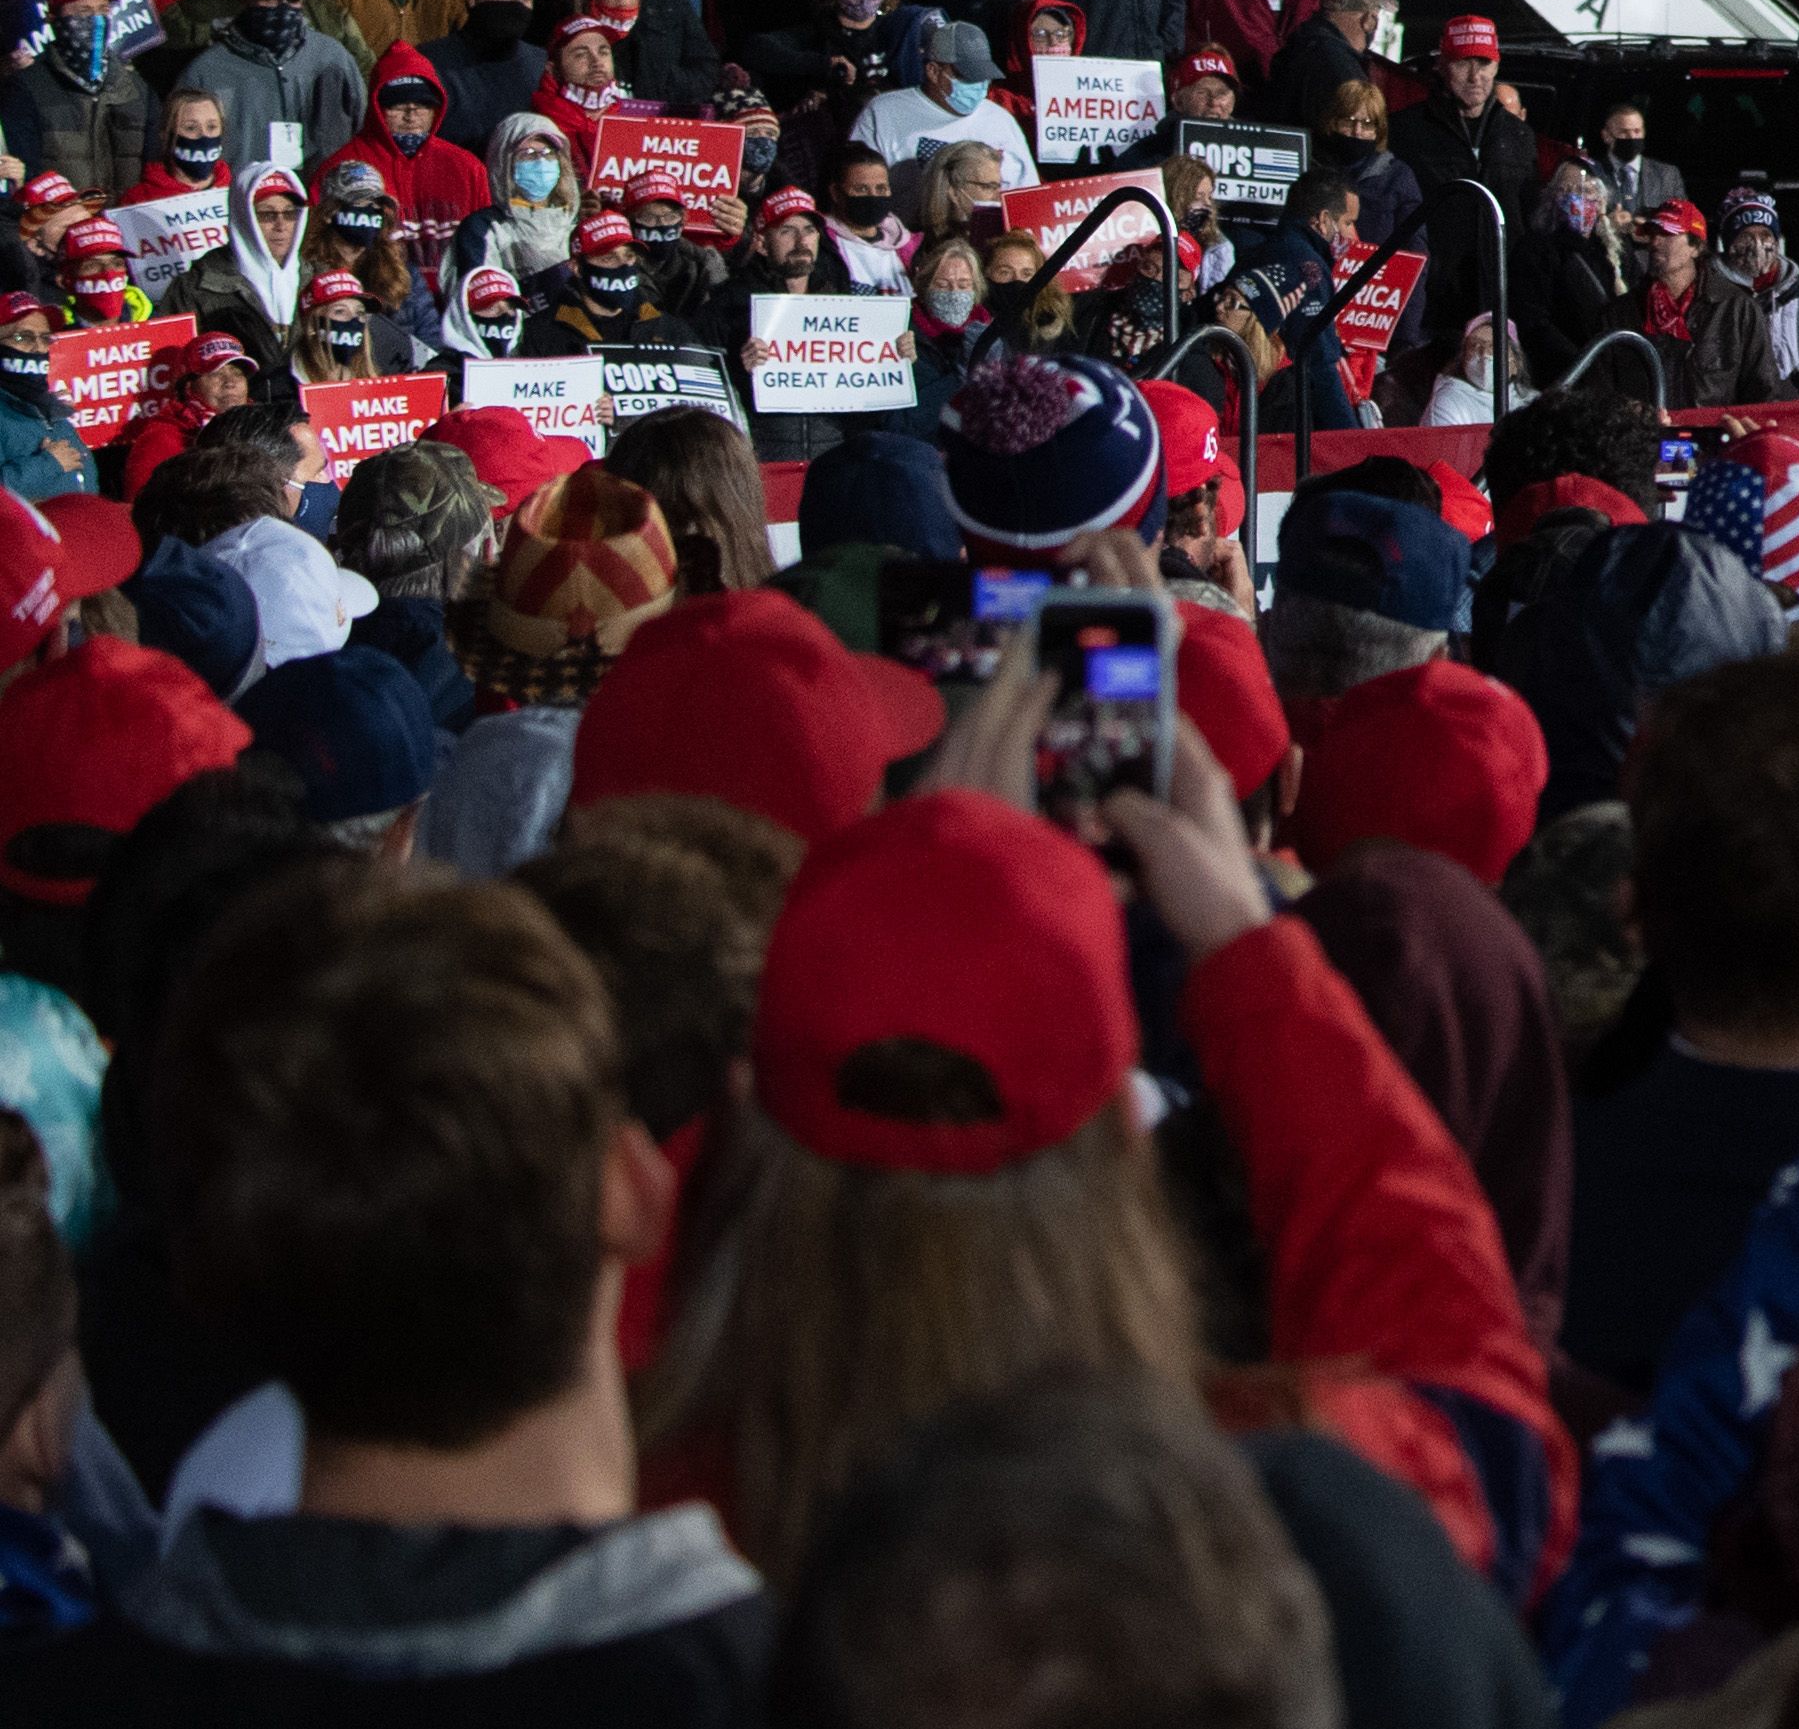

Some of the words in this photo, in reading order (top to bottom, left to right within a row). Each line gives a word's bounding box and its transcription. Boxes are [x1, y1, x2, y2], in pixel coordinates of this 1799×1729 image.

[1193, 58, 1227, 74] USA
[1077, 76, 1124, 92] MAKE
[1045, 97, 1159, 121] AMERICA
[1045, 126, 1103, 142] GREAT
[642, 135, 700, 157] MAKE
[1236, 183, 1284, 201] TRUM
[163, 204, 229, 227] MAKE
[1054, 195, 1104, 217] MAK
[337, 211, 383, 229] MAG
[136, 226, 230, 260] AMER
[1100, 245, 1142, 268] AGA
[145, 259, 188, 283] GRE
[1340, 257, 1387, 280] MAE
[590, 274, 640, 293] MAG
[477, 323, 515, 341] MAG
[803, 316, 859, 333] MAKE
[1344, 310, 1395, 332] AGAIN
[88, 341, 152, 368] MAKE
[765, 339, 899, 365] AMERICA
[1, 357, 49, 375] MAG
[54, 363, 172, 404] AMERIC
[603, 362, 678, 394] COPS
[763, 371, 826, 389] GREAT
[836, 370, 903, 388] AGAIN
[514, 380, 566, 399] MAKE
[67, 404, 122, 429] REAT
[352, 395, 409, 418] MAKE
[523, 402, 595, 430] ERICA
[619, 397, 659, 414] FOR
[321, 418, 438, 454] AMERIC
